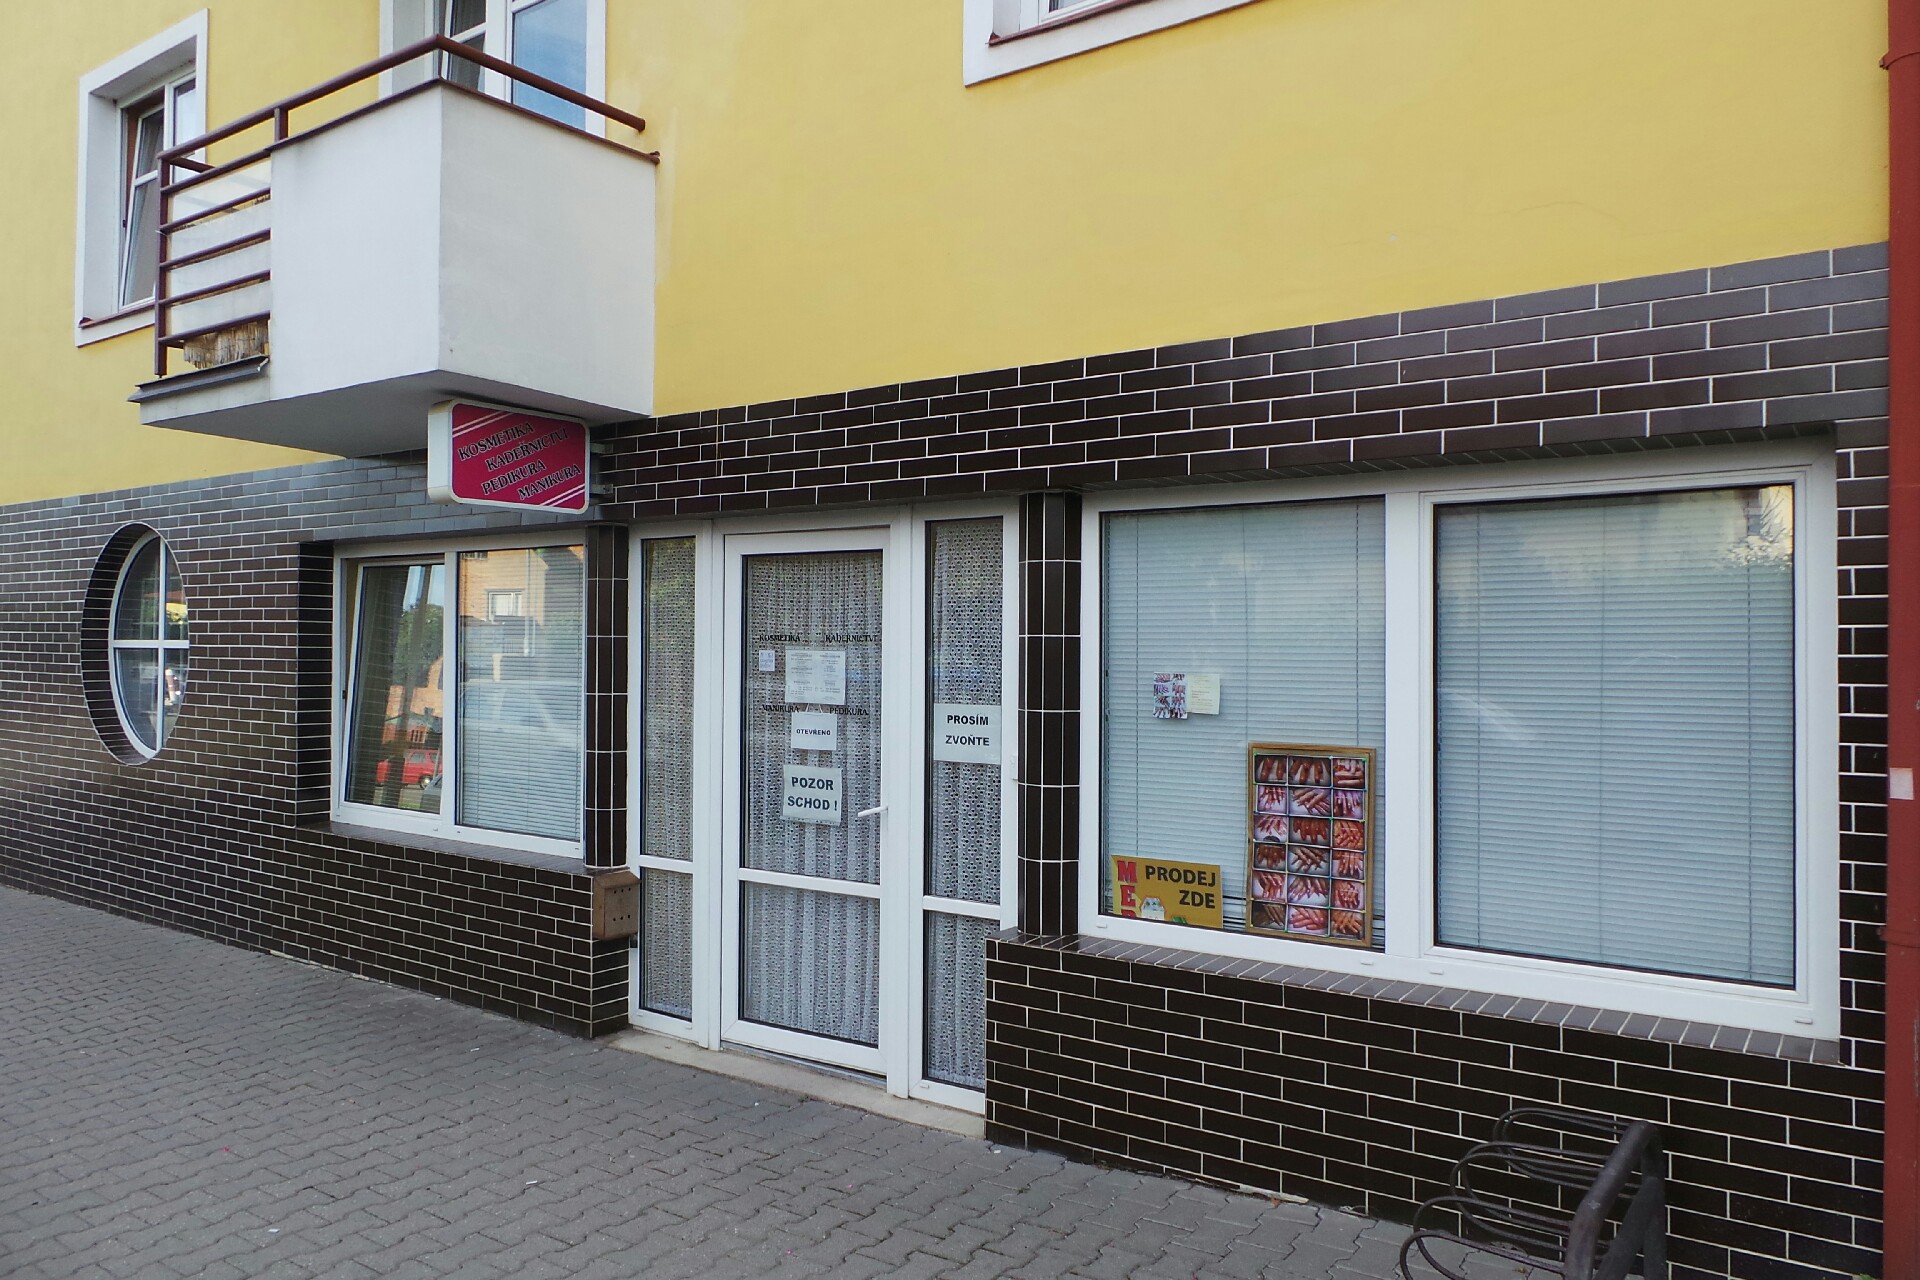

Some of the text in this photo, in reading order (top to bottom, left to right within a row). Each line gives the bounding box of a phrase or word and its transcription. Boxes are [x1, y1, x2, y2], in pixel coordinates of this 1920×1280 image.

[458, 422, 534, 461] KOSMETIKA
[481, 459, 547, 495] PEDIKURA
[517, 463, 582, 501] MANIKURA
[759, 634, 801, 643] KOSMETIKA
[947, 713, 989, 725] PROSÍM
[796, 728, 831, 736] OTEVŘENO
[945, 734, 990, 746] ZVOŇTE
[791, 776, 834, 791] POZOR
[787, 795, 838, 812] SCHOD !
[1145, 864, 1216, 887] PRODEJ
[1179, 889, 1216, 909] ZDE
